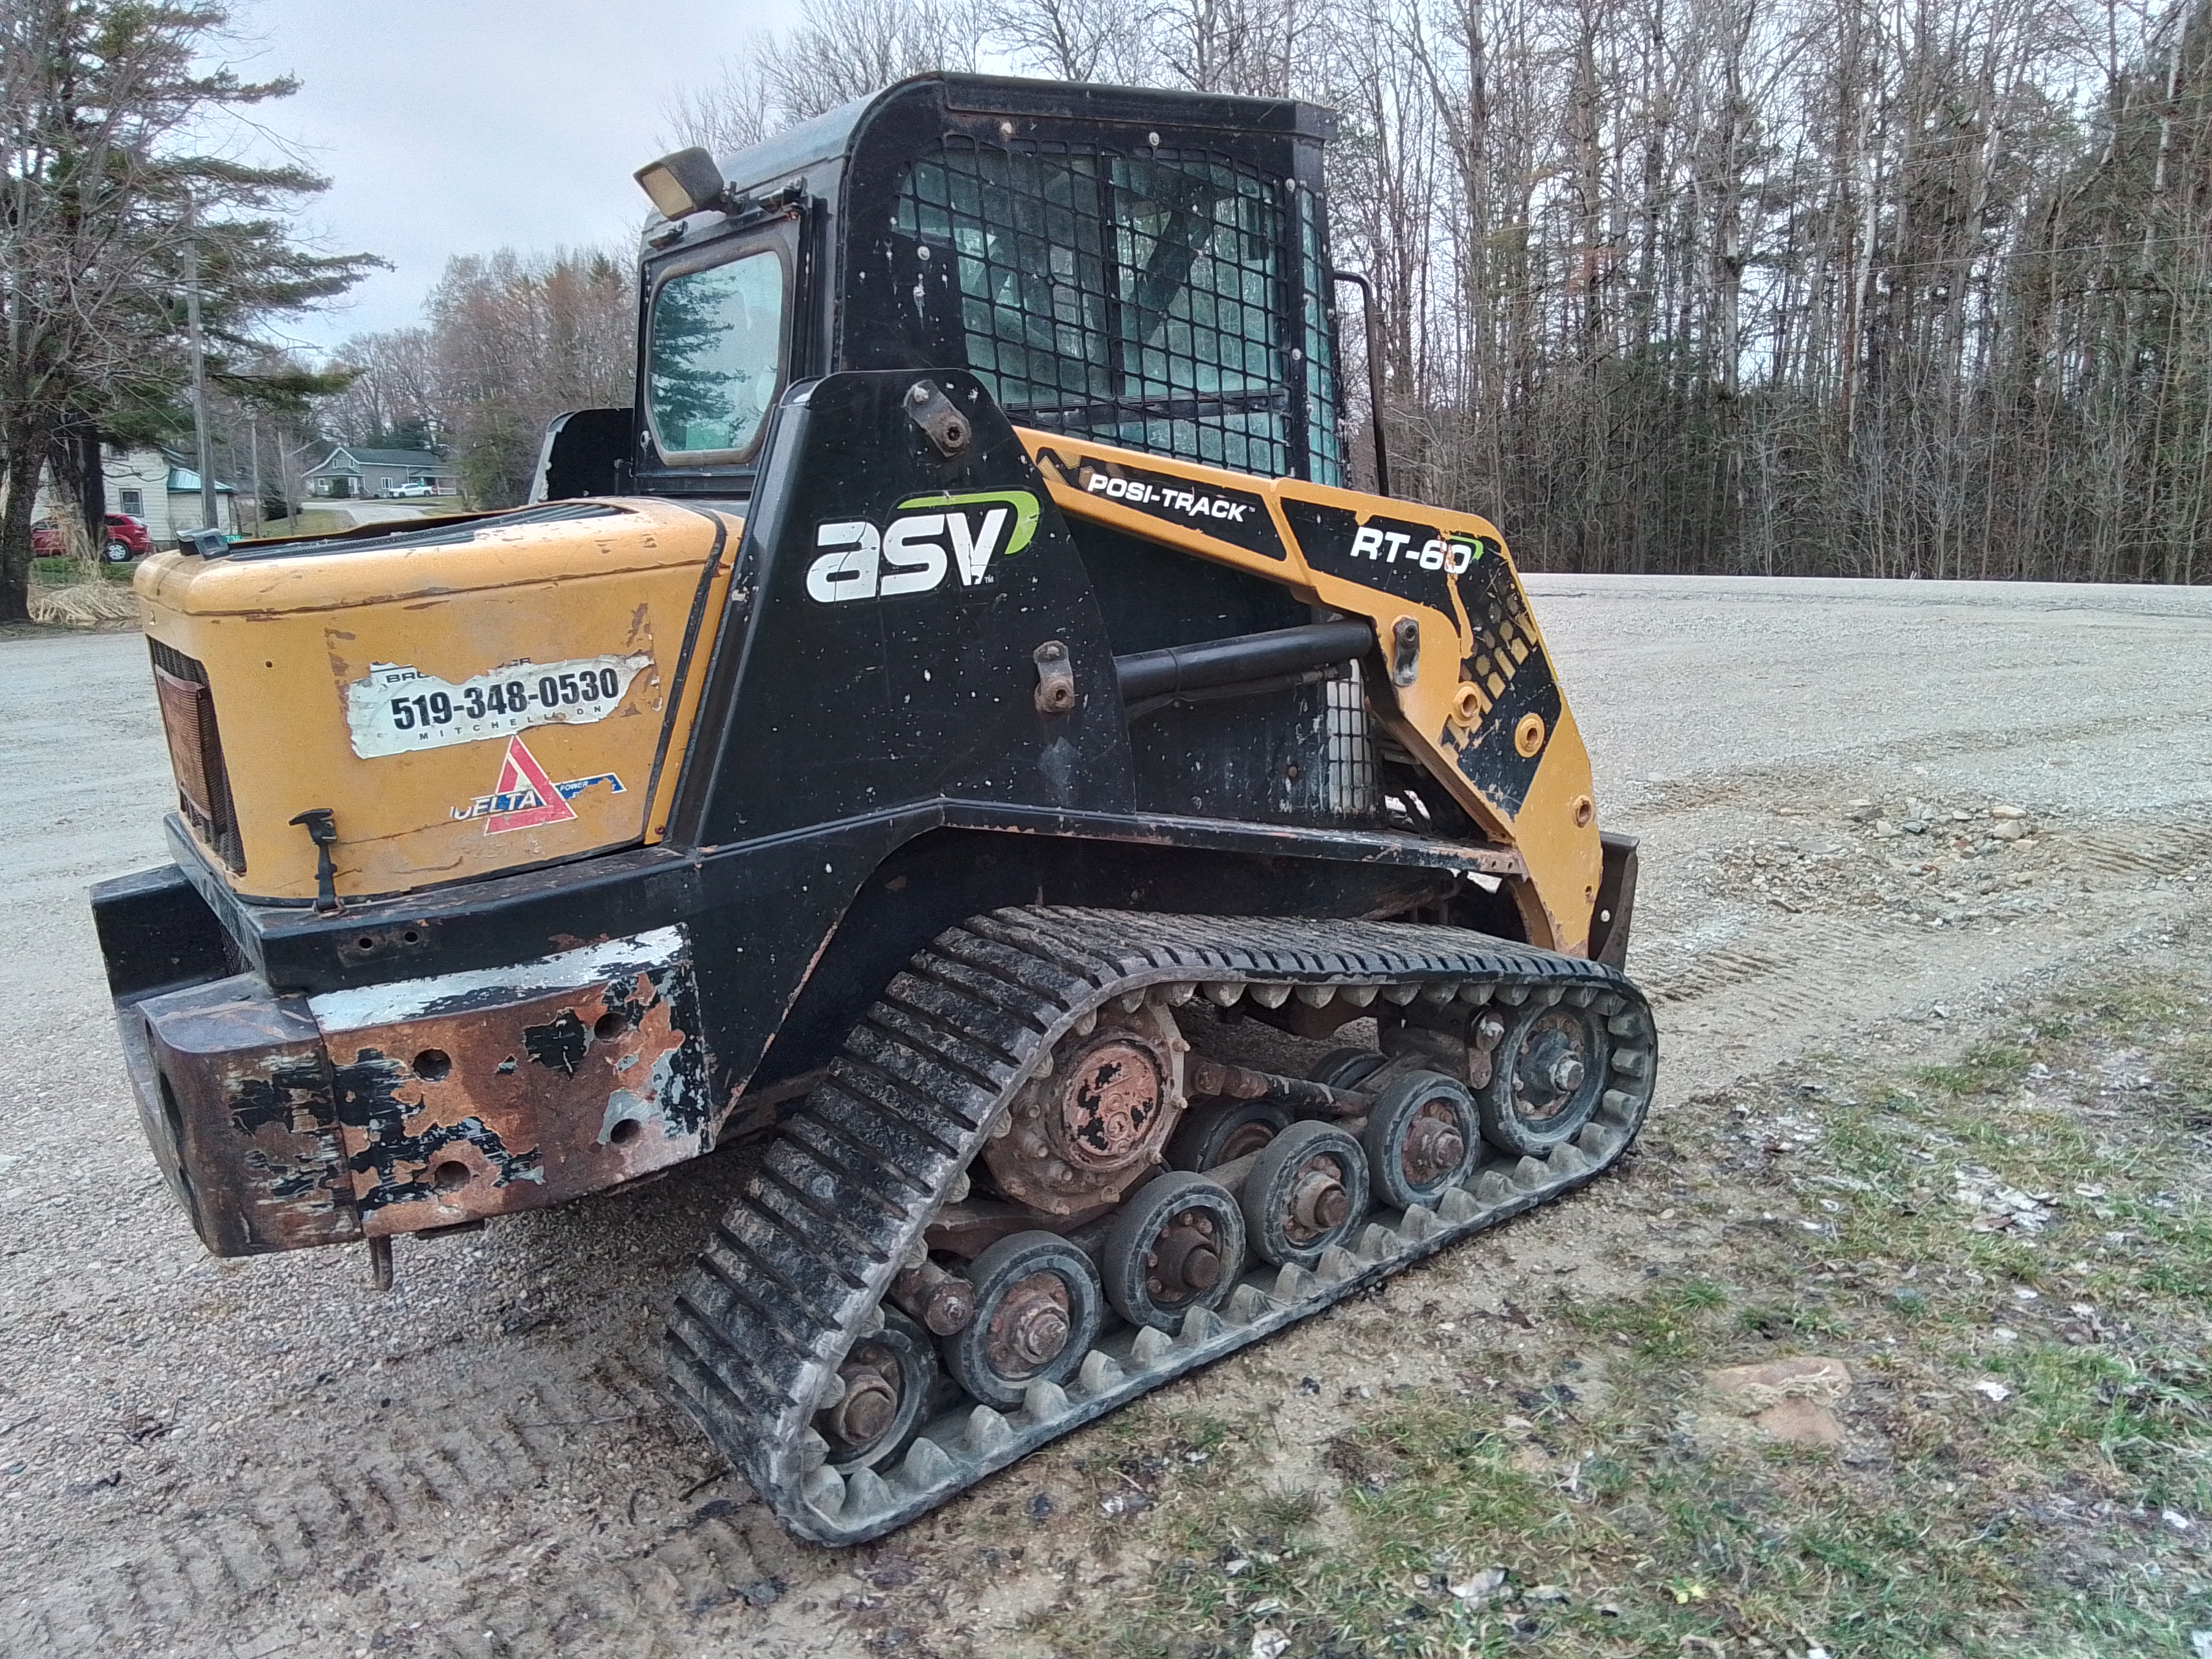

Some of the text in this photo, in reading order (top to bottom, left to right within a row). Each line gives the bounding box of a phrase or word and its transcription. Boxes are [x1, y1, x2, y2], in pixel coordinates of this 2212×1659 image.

[1087, 473, 1248, 522] POSI-TRACK
[1350, 526, 1472, 574] RT-60
[390, 668, 619, 730] 519-348-0530
[449, 790, 537, 820] DELTA
[560, 781, 588, 792] POWER
